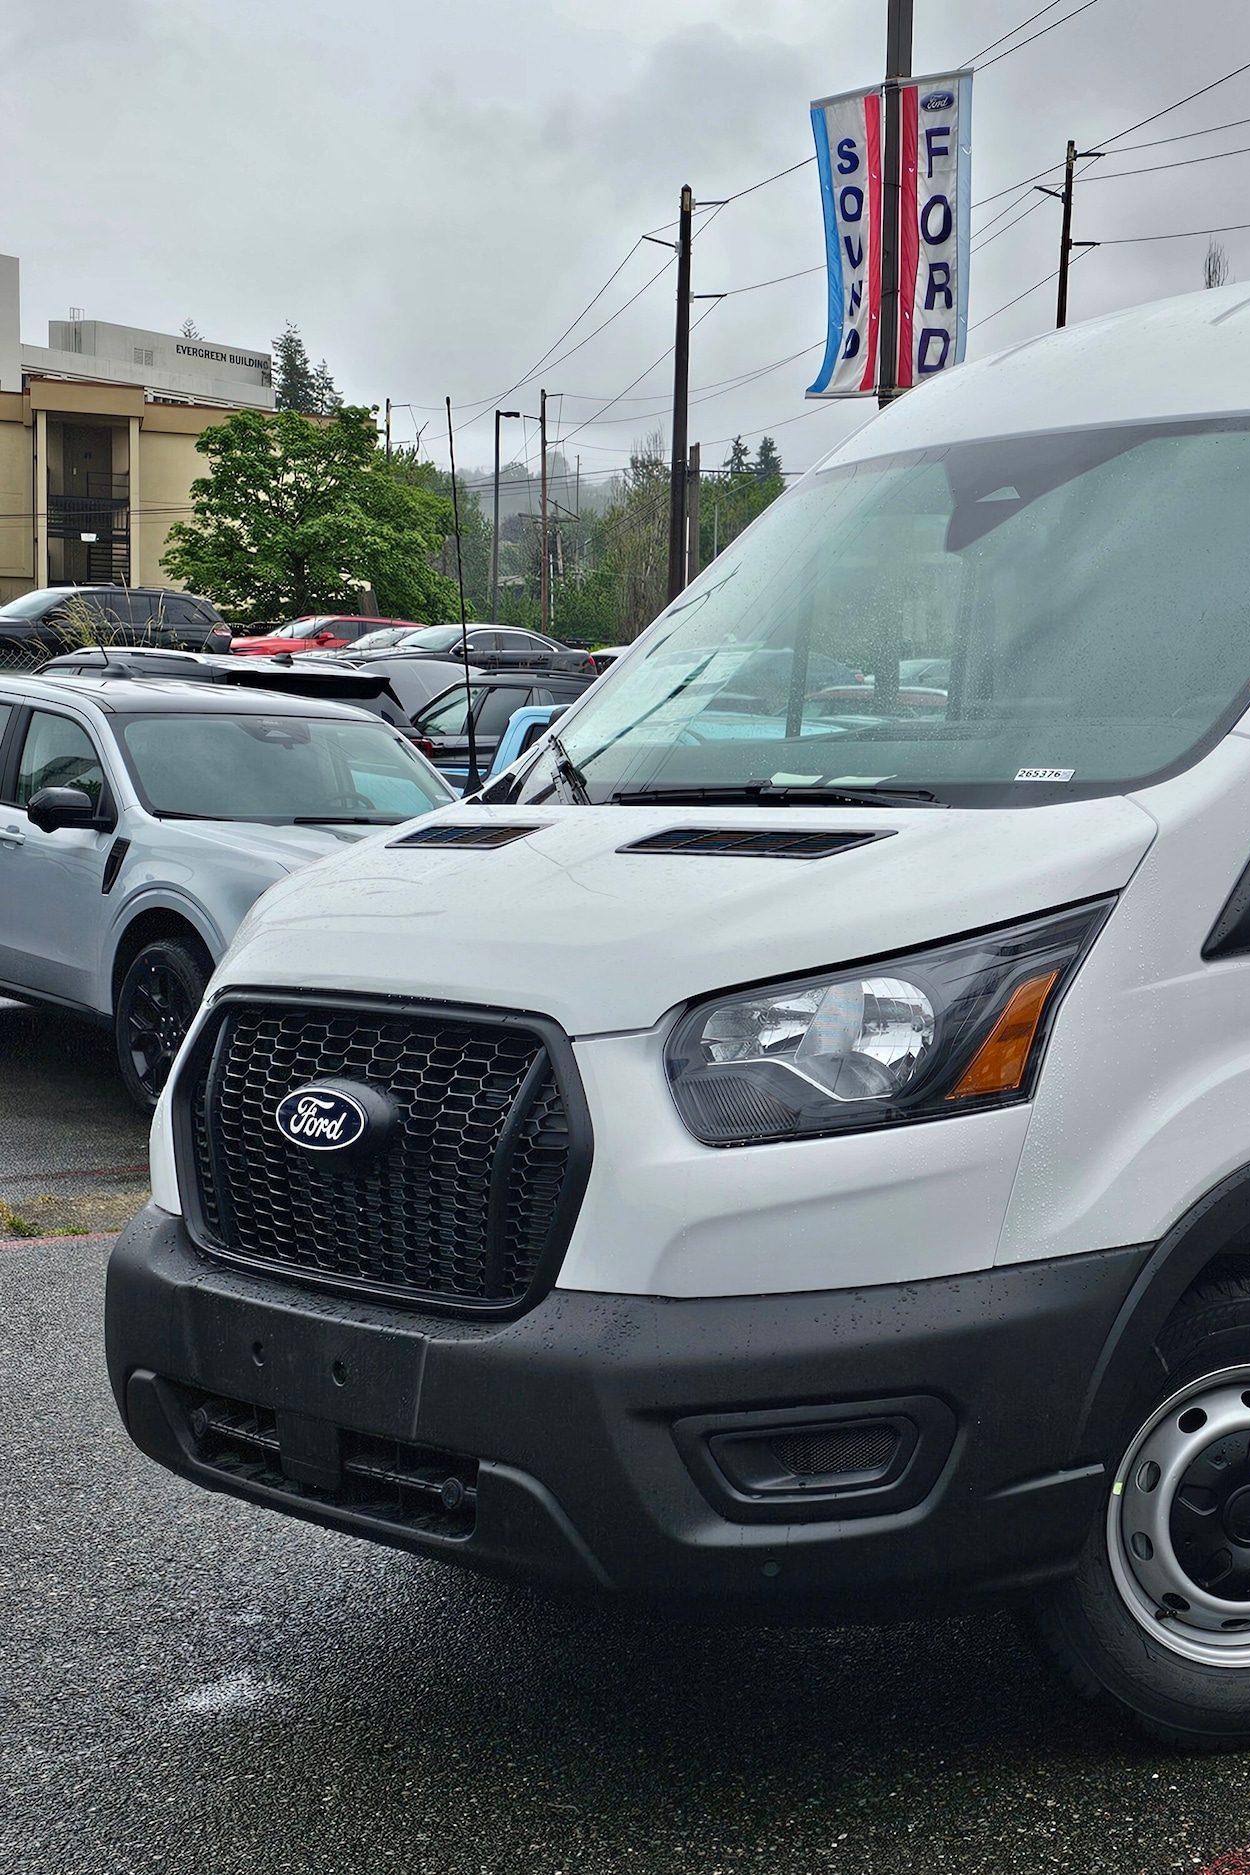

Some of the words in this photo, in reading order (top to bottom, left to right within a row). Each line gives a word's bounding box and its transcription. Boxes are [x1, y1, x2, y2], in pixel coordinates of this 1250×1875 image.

[927, 94, 948, 110] Ford
[918, 126, 953, 374] FORD
[176, 344, 227, 361] EVERGREEN
[229, 354, 269, 369] BUILDING
[1018, 769, 1062, 778] 265376
[290, 1096, 347, 1140] Ford
